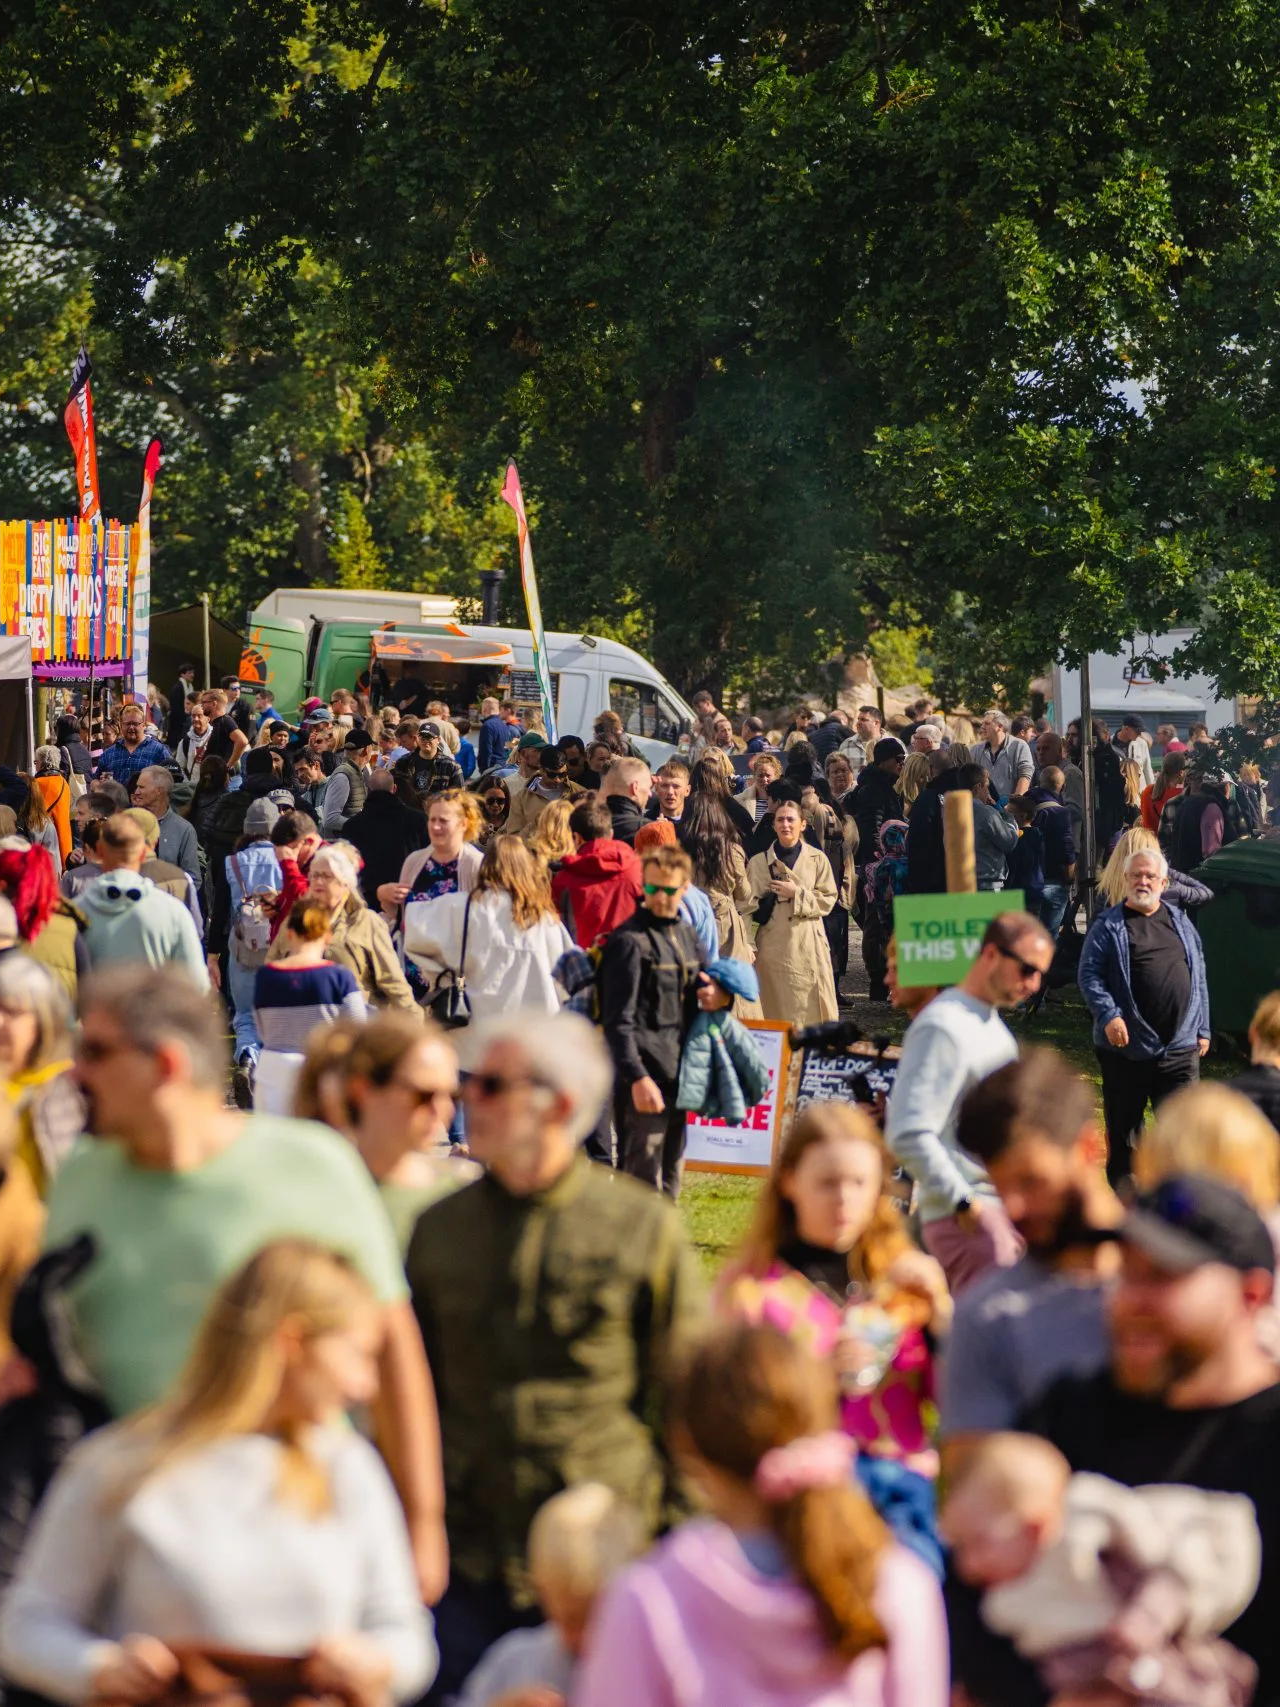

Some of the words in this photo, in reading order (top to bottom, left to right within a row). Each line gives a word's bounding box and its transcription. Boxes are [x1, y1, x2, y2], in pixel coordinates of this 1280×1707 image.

[33, 532, 50, 556] BIG
[57, 534, 79, 552] PULLED
[31, 556, 50, 579] EATS
[19, 583, 53, 613] DIRTY
[54, 573, 102, 618] NACHOS
[19, 616, 50, 649] FRIES
[900, 940, 956, 963] THIS
